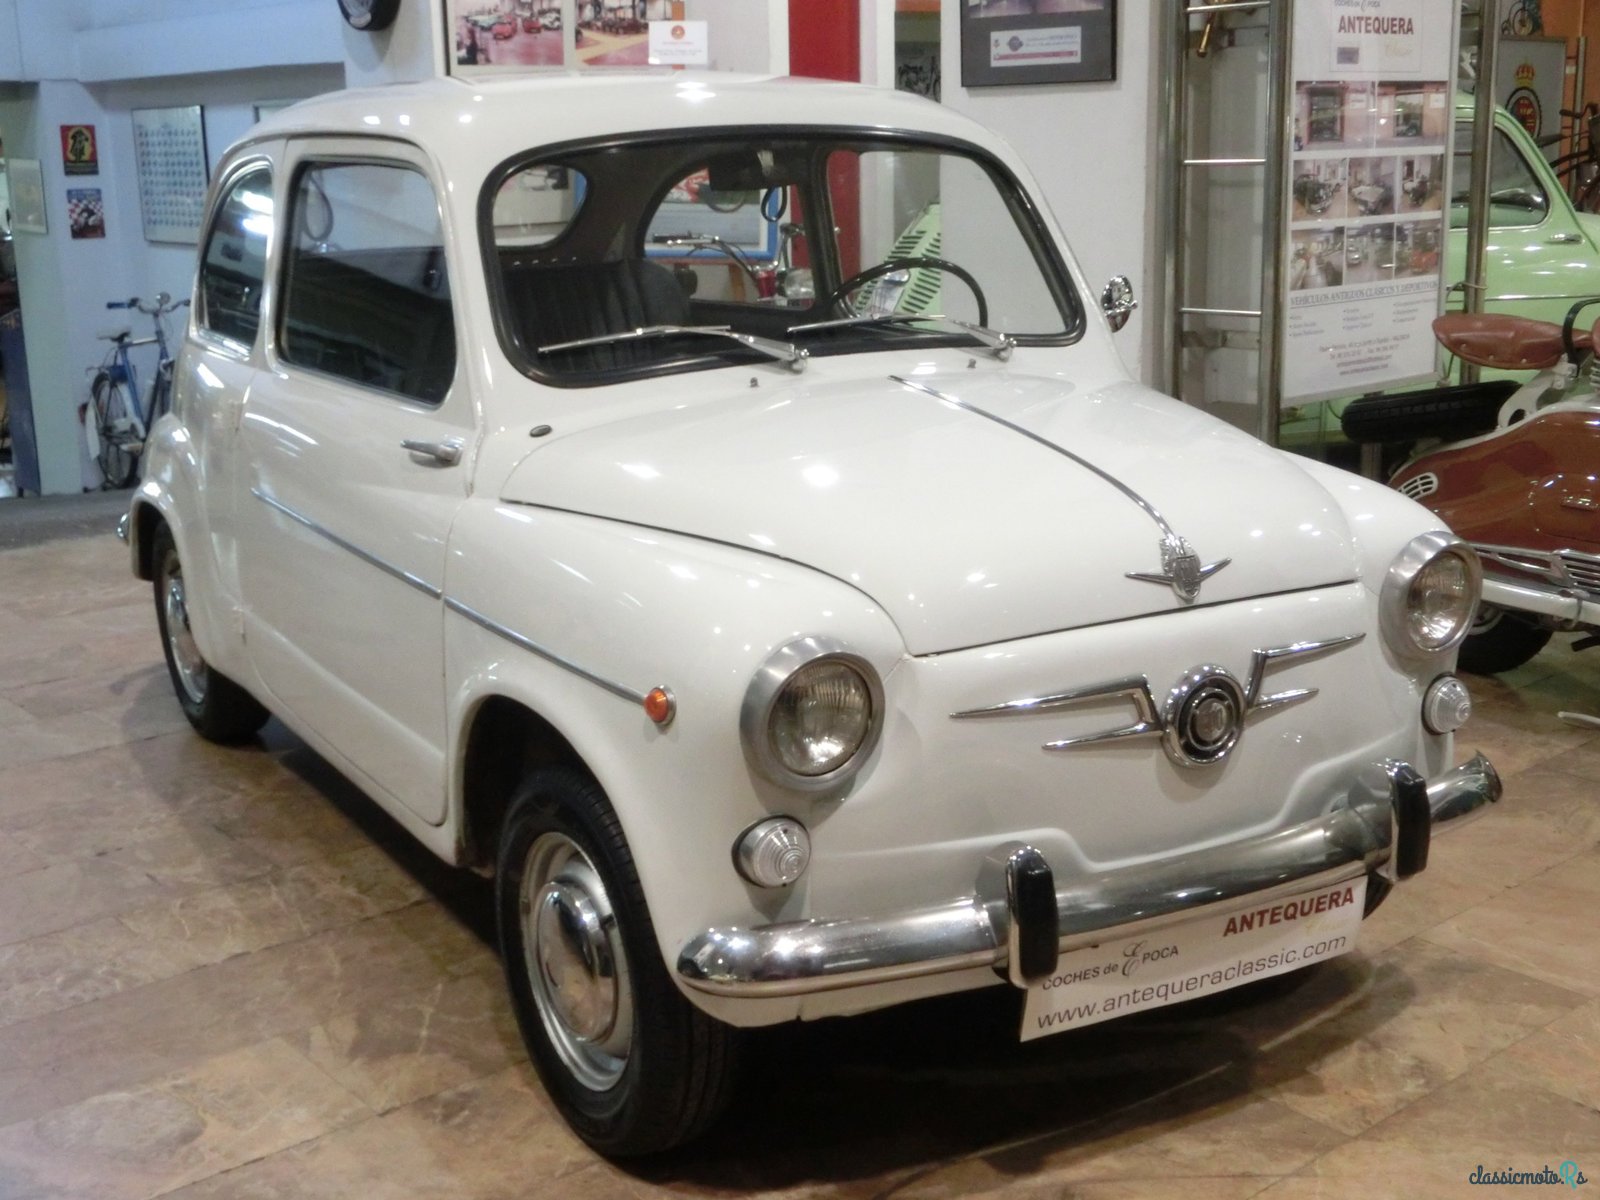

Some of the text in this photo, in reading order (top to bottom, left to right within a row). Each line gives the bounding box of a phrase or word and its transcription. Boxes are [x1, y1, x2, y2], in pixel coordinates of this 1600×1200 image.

[1338, 15, 1414, 35] ANTEQUERA
[1223, 887, 1354, 937] ANTEQUERA
[1037, 936, 1346, 1029] www.antequeraclassic.com
[1042, 966, 1100, 991] COCHES
[1103, 963, 1119, 976] de
